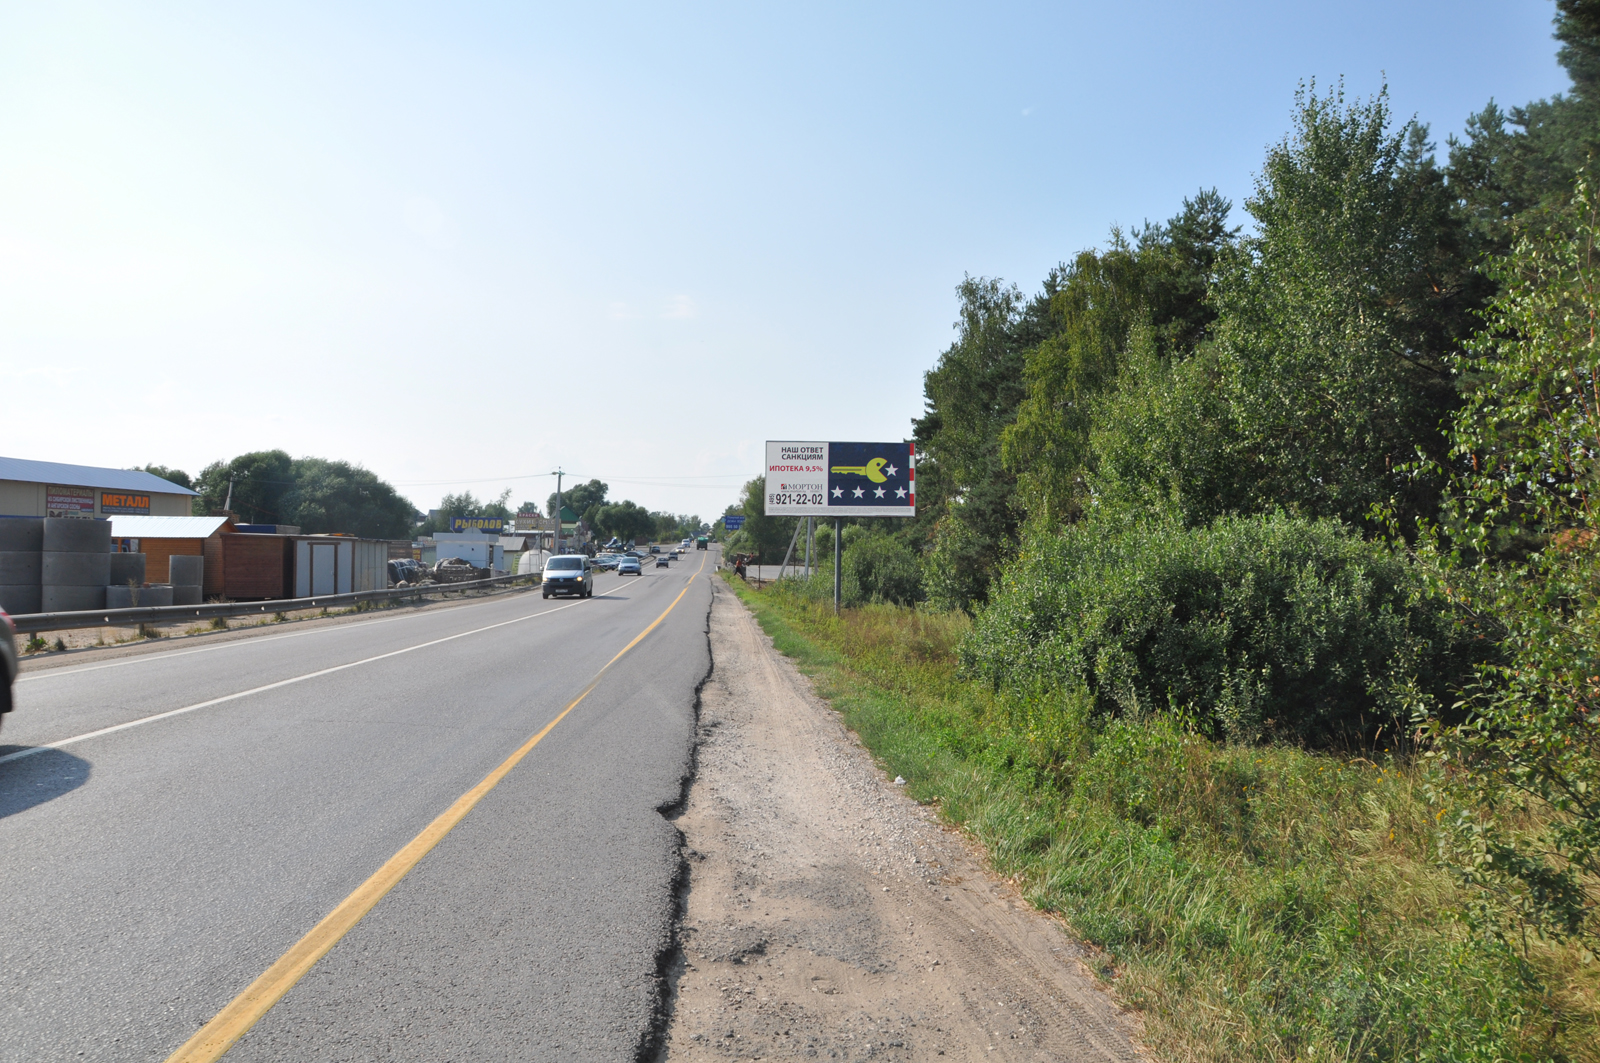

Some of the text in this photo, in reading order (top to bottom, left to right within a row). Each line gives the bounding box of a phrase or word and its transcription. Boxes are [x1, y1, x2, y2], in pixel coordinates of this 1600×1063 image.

[102, 494, 149, 508] МЕТАЛЛ
[775, 493, 823, 505] 921-22-02
[455, 519, 502, 529] РЫБОЛОВ
